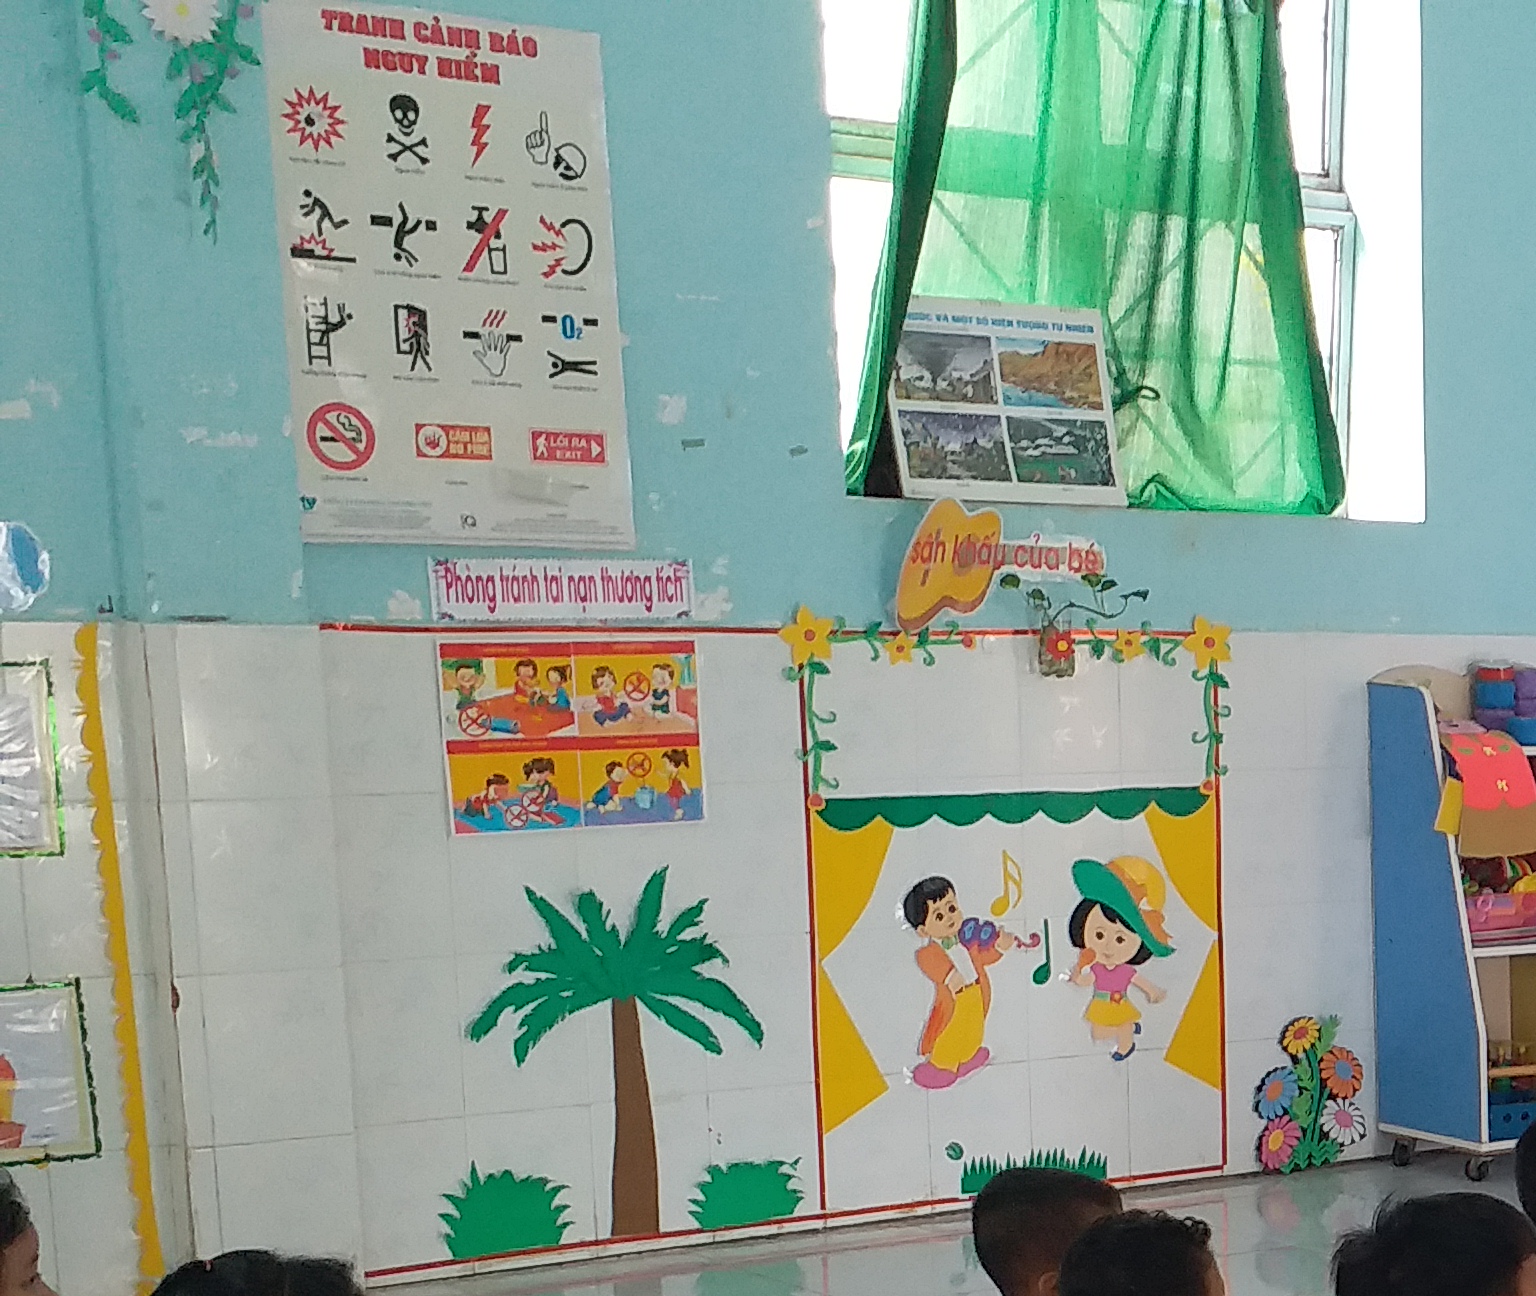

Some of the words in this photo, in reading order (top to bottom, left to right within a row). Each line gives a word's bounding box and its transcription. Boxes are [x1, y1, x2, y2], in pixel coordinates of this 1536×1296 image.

[321, 8, 406, 41] TRANH
[488, 28, 538, 58] BÁO
[363, 47, 429, 76] NGUY
[1013, 532, 1060, 571] của
[1067, 541, 1102, 575] bé
[443, 560, 497, 614] Phòng
[499, 564, 541, 604] tránh
[543, 565, 564, 604] tai
[567, 575, 598, 613] nạn
[655, 565, 685, 604] tích
